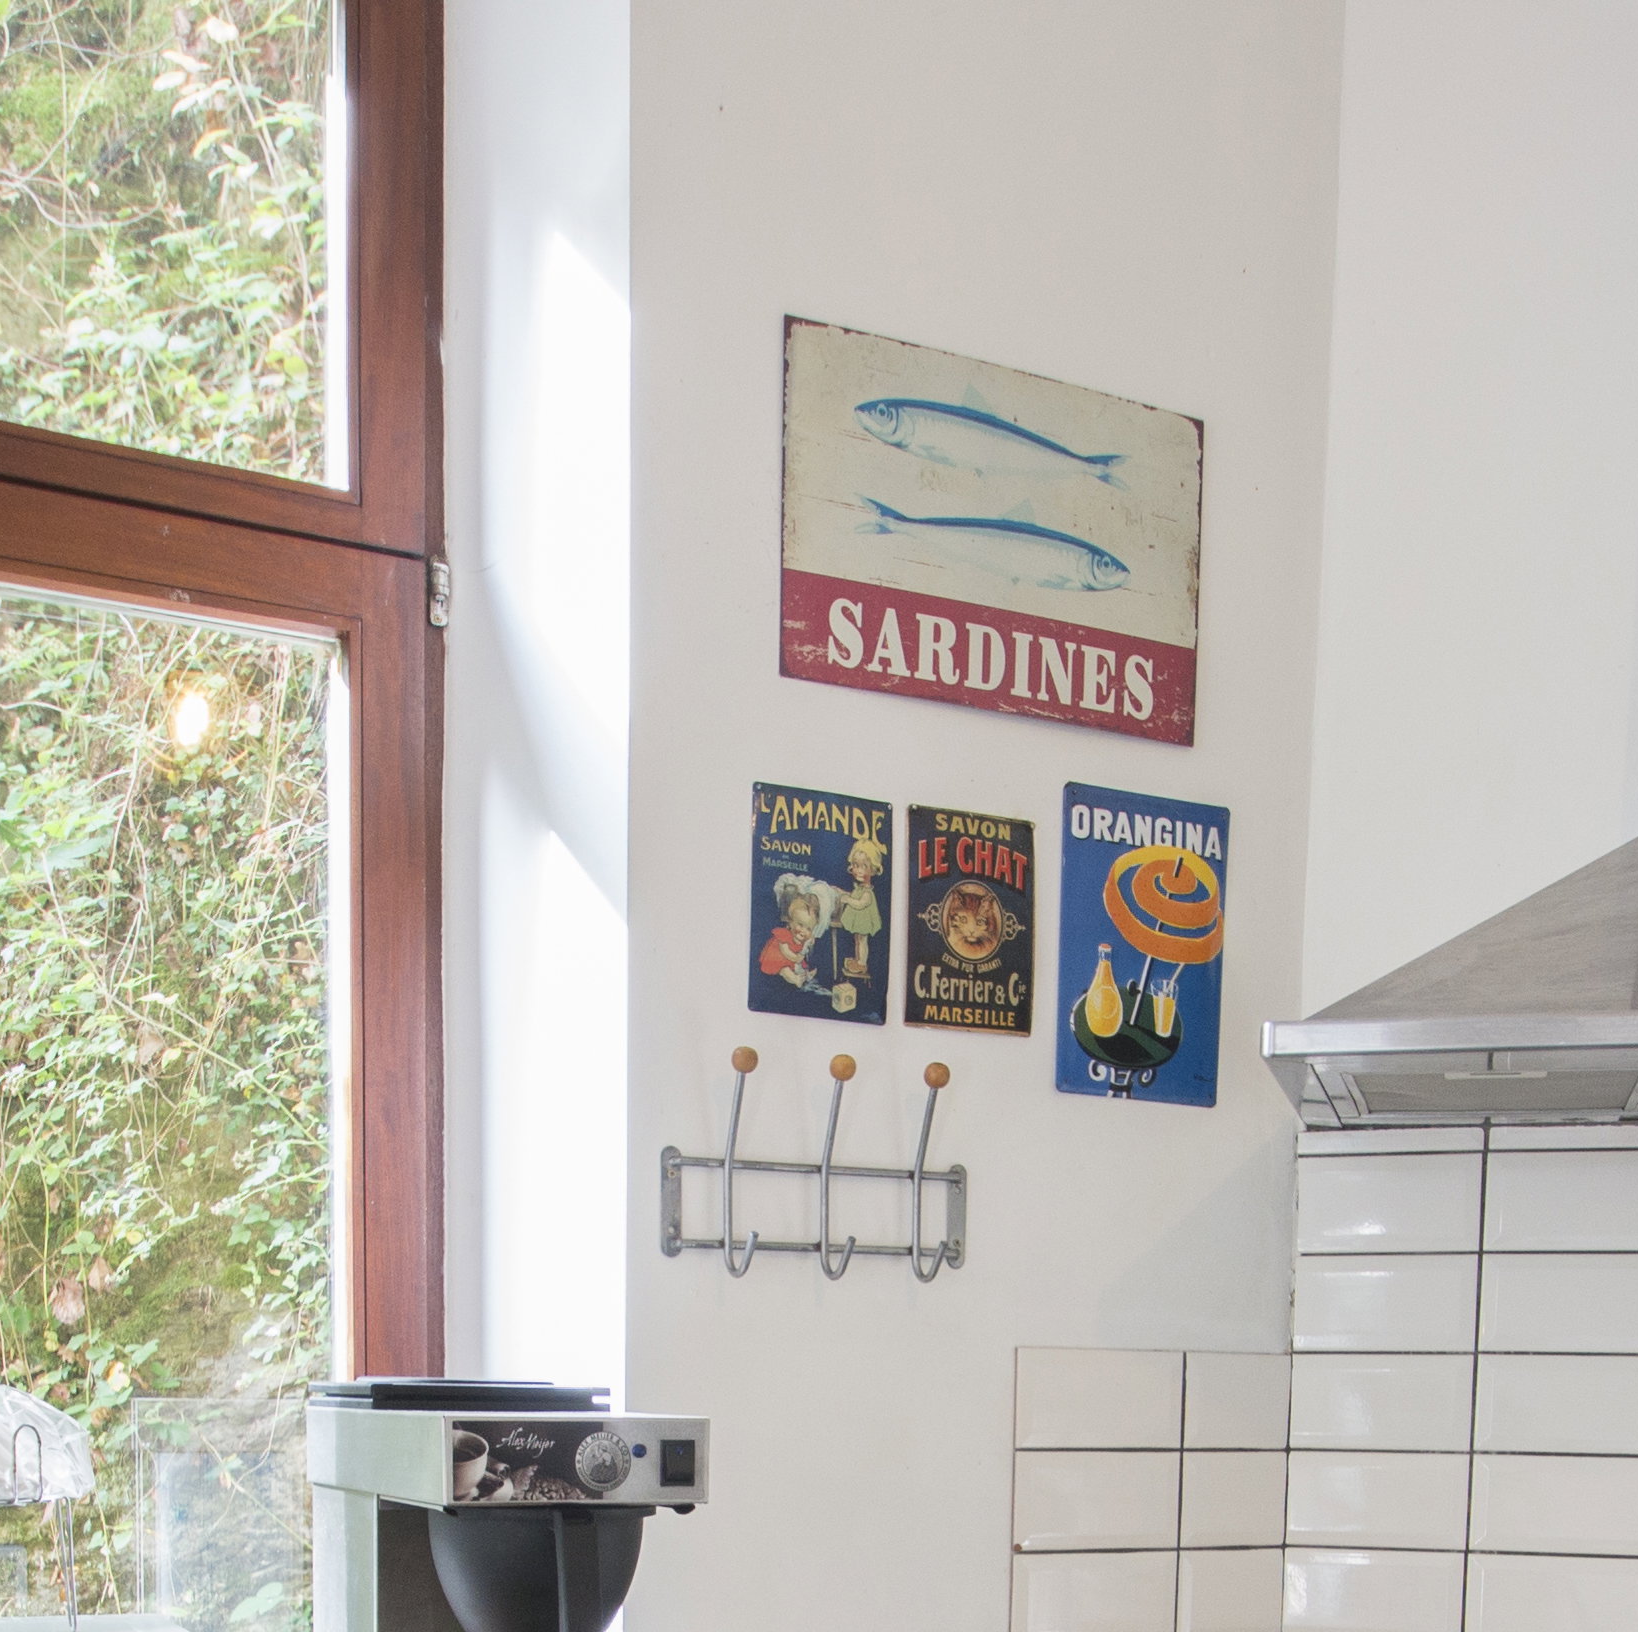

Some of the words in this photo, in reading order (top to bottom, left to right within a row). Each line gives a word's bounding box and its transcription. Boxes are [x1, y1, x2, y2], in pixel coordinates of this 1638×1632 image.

[826, 597, 1156, 722] SARDINES
[760, 793, 888, 856] L'AMANDE
[935, 813, 1012, 841] SAVON
[1071, 804, 1223, 861] ORANGINA
[760, 836, 812, 856] SAVON
[762, 857, 809, 872] MARSEILLE
[918, 837, 949, 879] LE
[956, 836, 1028, 891] CHAT
[941, 952, 960, 970] EXTRA
[994, 985, 1006, 1005] &
[924, 1005, 1016, 1027] MARSEILLE
[496, 1427, 526, 1450] Alex
